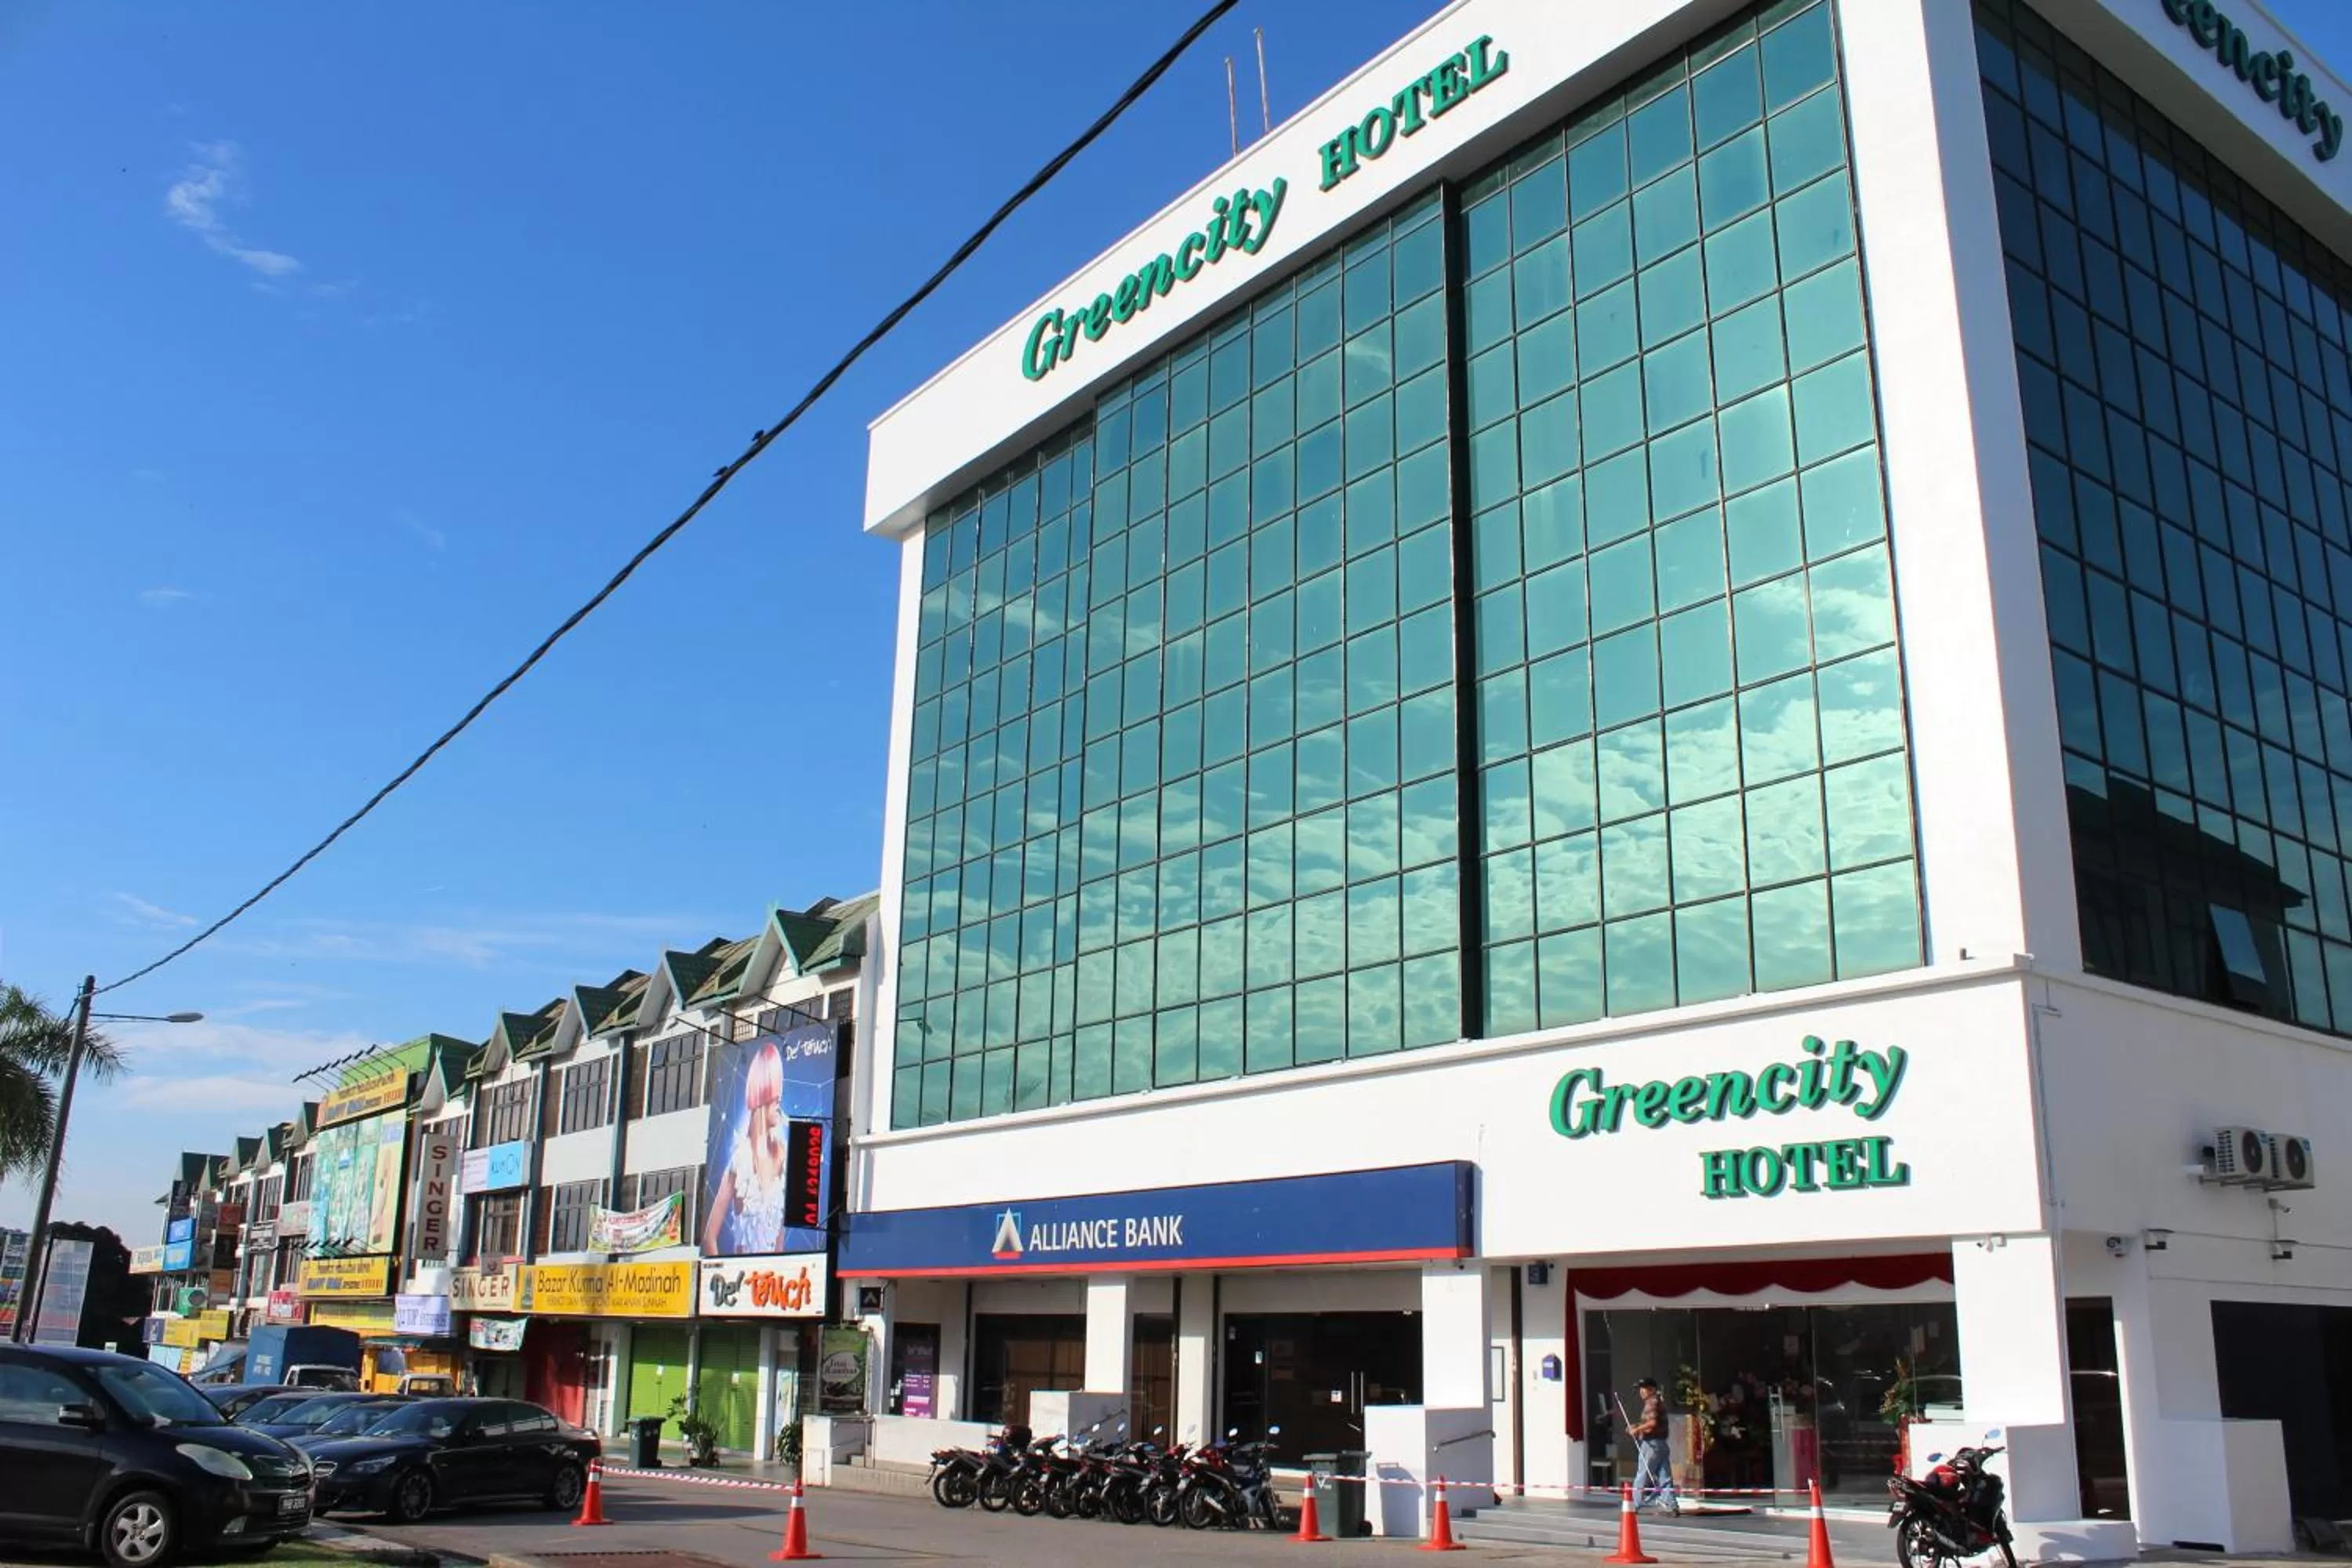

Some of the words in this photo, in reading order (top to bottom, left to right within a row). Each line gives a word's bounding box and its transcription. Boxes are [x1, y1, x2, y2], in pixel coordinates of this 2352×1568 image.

[1022, 177, 1287, 382] Greencity
[1318, 34, 1508, 192] HOTEL
[1549, 1035, 1908, 1139] Greencity
[423, 1145, 448, 1251] SINGER
[1698, 1136, 1911, 1200] HOTEL
[1029, 1220, 1119, 1252] ALLIANCE
[1125, 1214, 1184, 1248] BANK
[452, 1276, 510, 1298] SINGER
[537, 1269, 567, 1293] Bazar
[569, 1268, 604, 1293] Kurma
[607, 1266, 681, 1294] Al-Madinah
